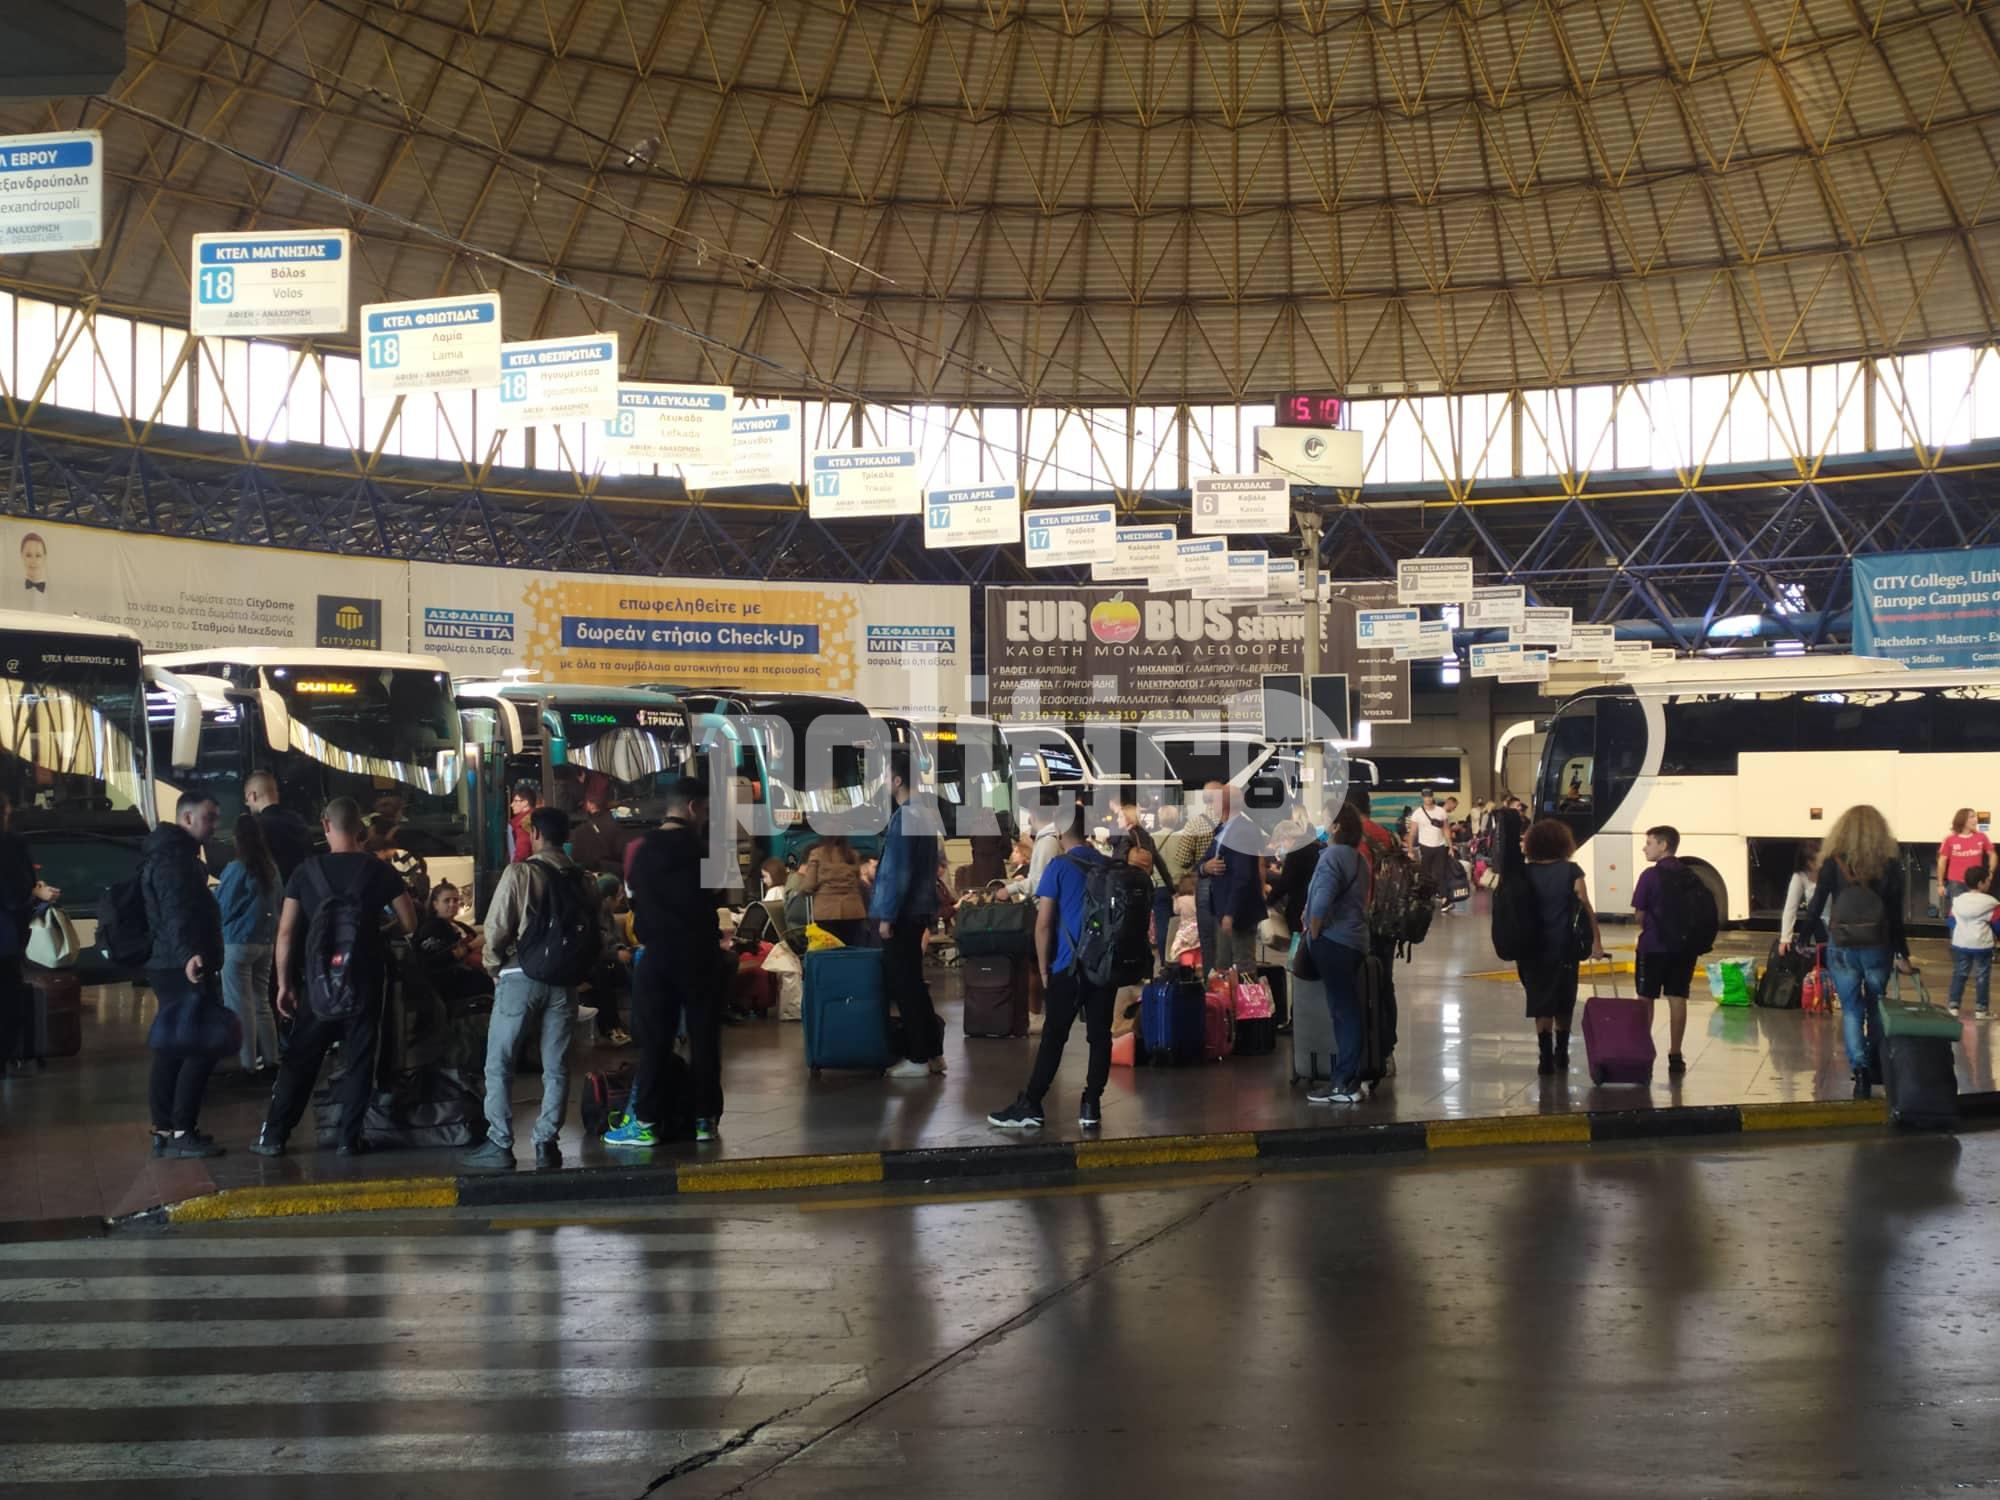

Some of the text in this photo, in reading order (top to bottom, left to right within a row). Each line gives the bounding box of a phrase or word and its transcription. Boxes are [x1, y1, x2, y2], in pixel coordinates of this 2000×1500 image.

[11, 150, 58, 166] ΕΒΡΟΥ
[216, 245, 326, 260] ΚΤΕΛ ΜΑΓΝΗΣΙΑΣ
[202, 271, 233, 300] 18
[273, 287, 304, 299] Volos
[383, 309, 480, 328] ΚΤΕΛ ΦΘΙΩΤΙΔΑΣ
[371, 338, 398, 365] 18
[509, 347, 604, 366] ΚΤΕΛ ΘΕΣΠΡΩΤΙΑΣ
[502, 375, 526, 400] 18
[622, 393, 711, 407] ΚΤΕΛ ΛΕΥΚΑΔΑΣ
[732, 419, 778, 431] ΑΚΥΝΘΟΥ
[828, 456, 901, 467] ΚΤΕΛ ΤΡΙΚΑΛΩΝ
[816, 475, 839, 494] 17
[1234, 481, 1271, 489] ΚΑΒΑΛΑΣ
[948, 493, 968, 501] ΚΤΕΛ
[1202, 496, 1213, 513] 6
[931, 509, 949, 526] 17
[1030, 531, 1049, 547] 17
[1405, 576, 1414, 589] 7
[1874, 576, 1908, 590] CITY
[1911, 573, 1968, 589] College,
[246, 597, 294, 611] CityDome
[619, 598, 761, 616] επωφεληθείτε με
[1874, 595, 1926, 610] Europe
[1930, 592, 1989, 607] Campus
[1471, 603, 1478, 615] 7
[192, 622, 235, 635] Σταθμού
[238, 624, 293, 638] Μακεδονία
[577, 622, 804, 649] δωρεάν ετήσιο Check-Up
[1238, 616, 1328, 641] SERVIE
[1361, 623, 1373, 636] 14
[321, 636, 377, 648] CITYDOME
[1874, 634, 1980, 647] Bachelors Masters
[1006, 643, 1328, 656] ΚΑΘΕΤΗ ΜΟΝΑΔΑ ΛΕΩΦΟΡΕΙΝ
[1912, 655, 1945, 664] Studies
[560, 659, 820, 676] με όλα τα συμβόλαια αυτοκινήτου και περιουσίας
[1137, 664, 1184, 674] ΜΗΧΑΝΙΚΟΙ
[993, 696, 1034, 705] ΕΜΠΟΡΙΑ
[1036, 695, 1095, 705] ΛΕΩΦΟΡΕΙΩΝ
[1102, 695, 1168, 704] ΑΝΤΑΛΛΑΚΤΙΚΑ
[647, 716, 684, 727] ΤΡΙΚΑΛΑ
[1020, 711, 1049, 721] 2310
[1108, 711, 1137, 720] 2310
[1140, 710, 1189, 720] 754.310
